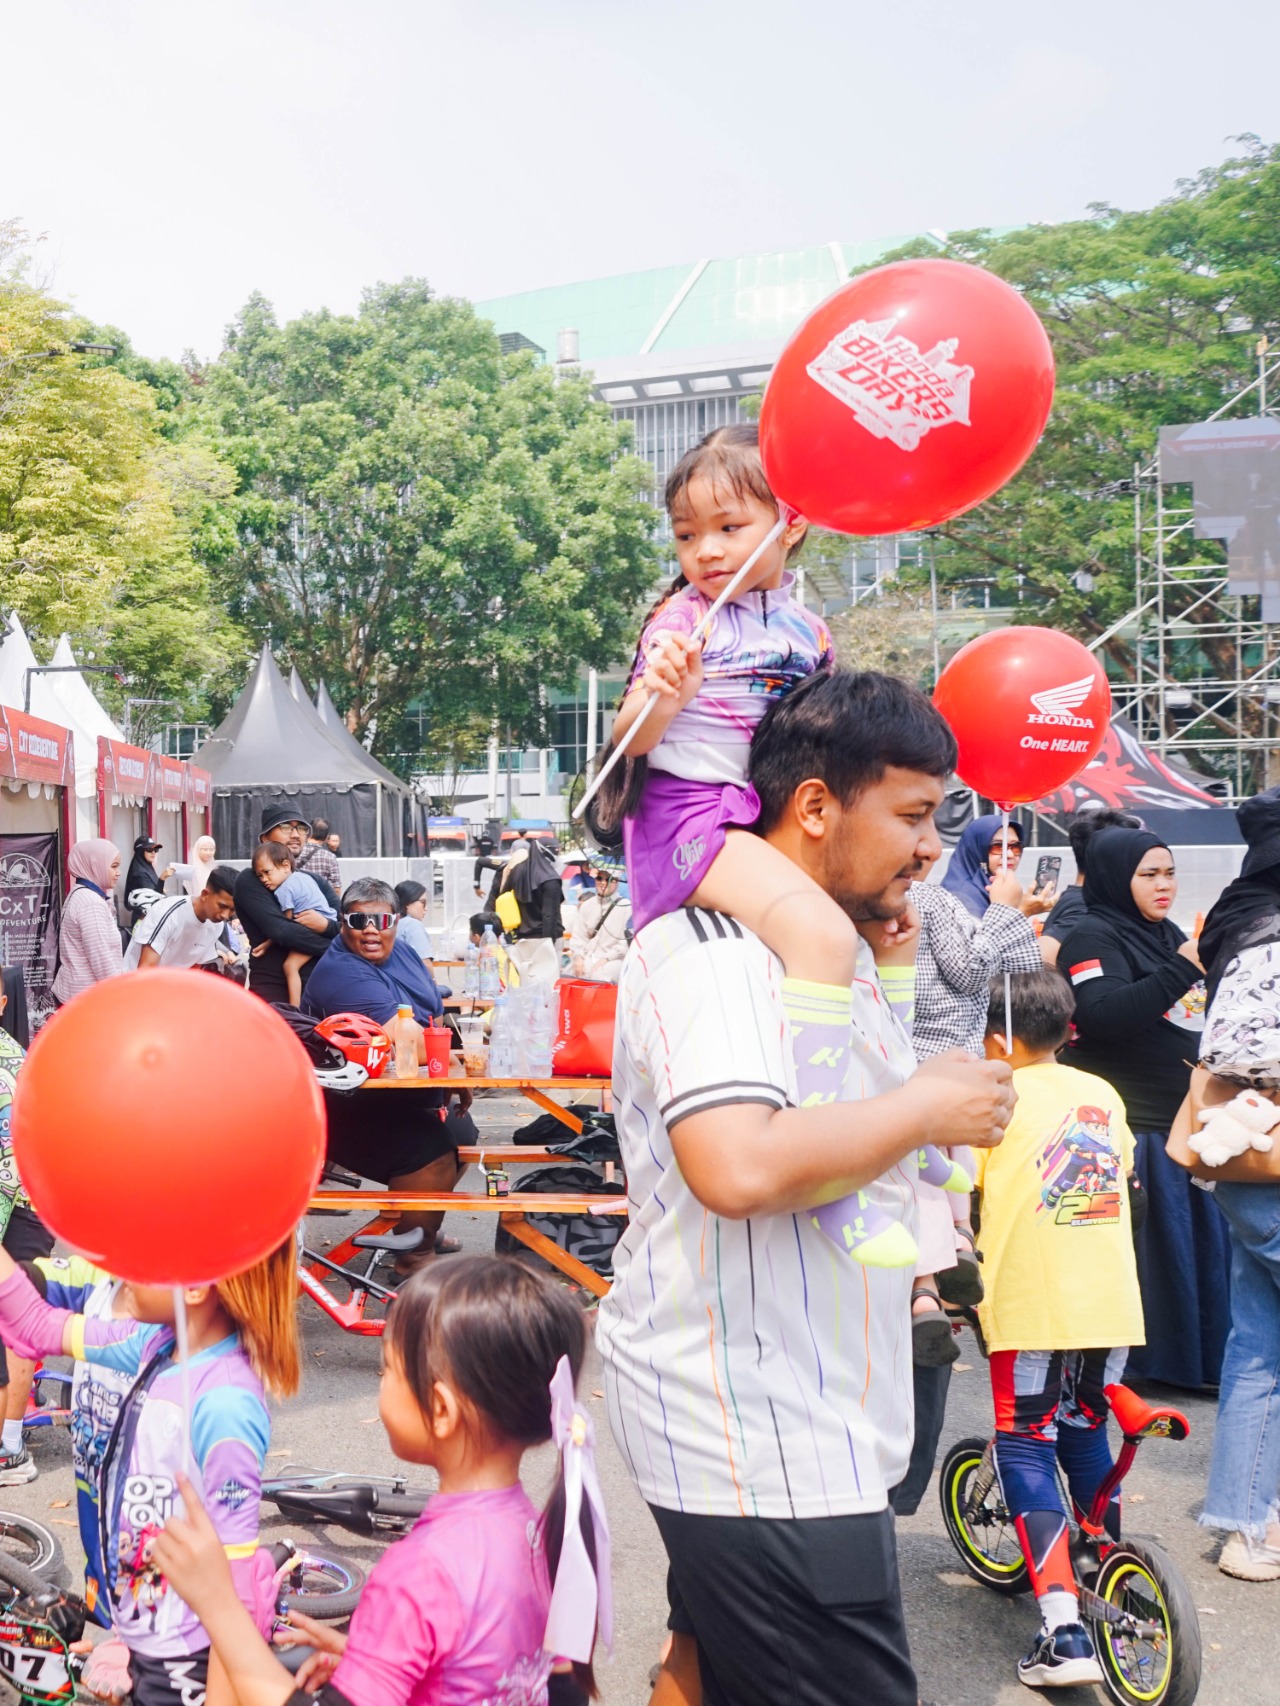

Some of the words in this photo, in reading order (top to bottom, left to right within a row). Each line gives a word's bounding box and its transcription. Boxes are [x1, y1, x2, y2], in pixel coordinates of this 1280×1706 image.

[836, 361, 906, 412] DAY
[842, 335, 955, 422] BIKERS
[886, 340, 955, 400] Honda
[1026, 713, 1095, 729] HONDA
[1020, 735, 1049, 751] One
[1054, 1192, 1121, 1226] 25
[0, 1646, 47, 1683] 07
